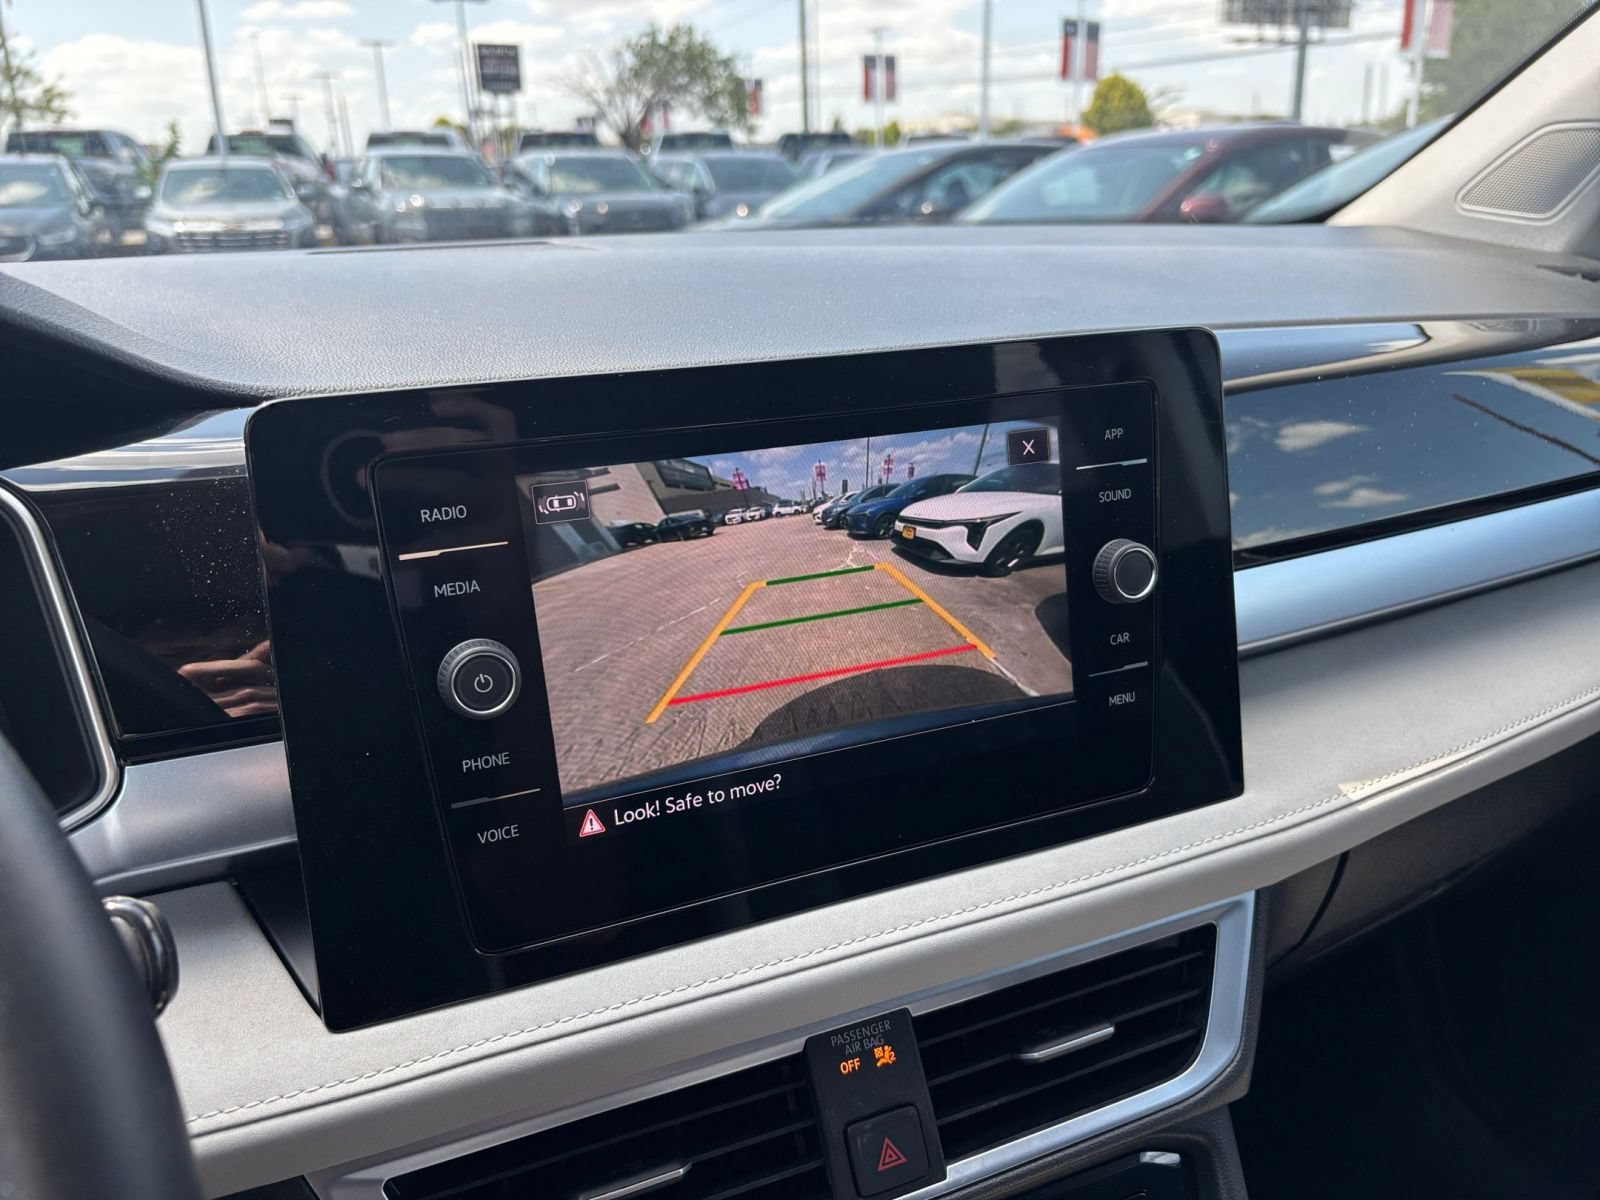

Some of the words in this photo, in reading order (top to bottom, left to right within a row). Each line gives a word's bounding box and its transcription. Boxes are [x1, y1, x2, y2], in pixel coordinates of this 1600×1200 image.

[1104, 428, 1124, 440] APP
[1099, 488, 1132, 503] SOUND
[420, 505, 467, 523] RADIO
[434, 580, 480, 598] MEDIA
[1110, 632, 1130, 645] CAR
[1109, 691, 1136, 707] MENU
[462, 752, 511, 773] PHONE
[614, 800, 660, 825] Look!
[665, 793, 703, 814] Safe
[707, 789, 726, 804] to
[730, 773, 782, 799] move?
[477, 824, 520, 844] VOICE
[830, 1020, 892, 1047] PASSENGER
[845, 1042, 862, 1056] AIR
[863, 1035, 884, 1048] BAG
[840, 1058, 860, 1075] OFF
